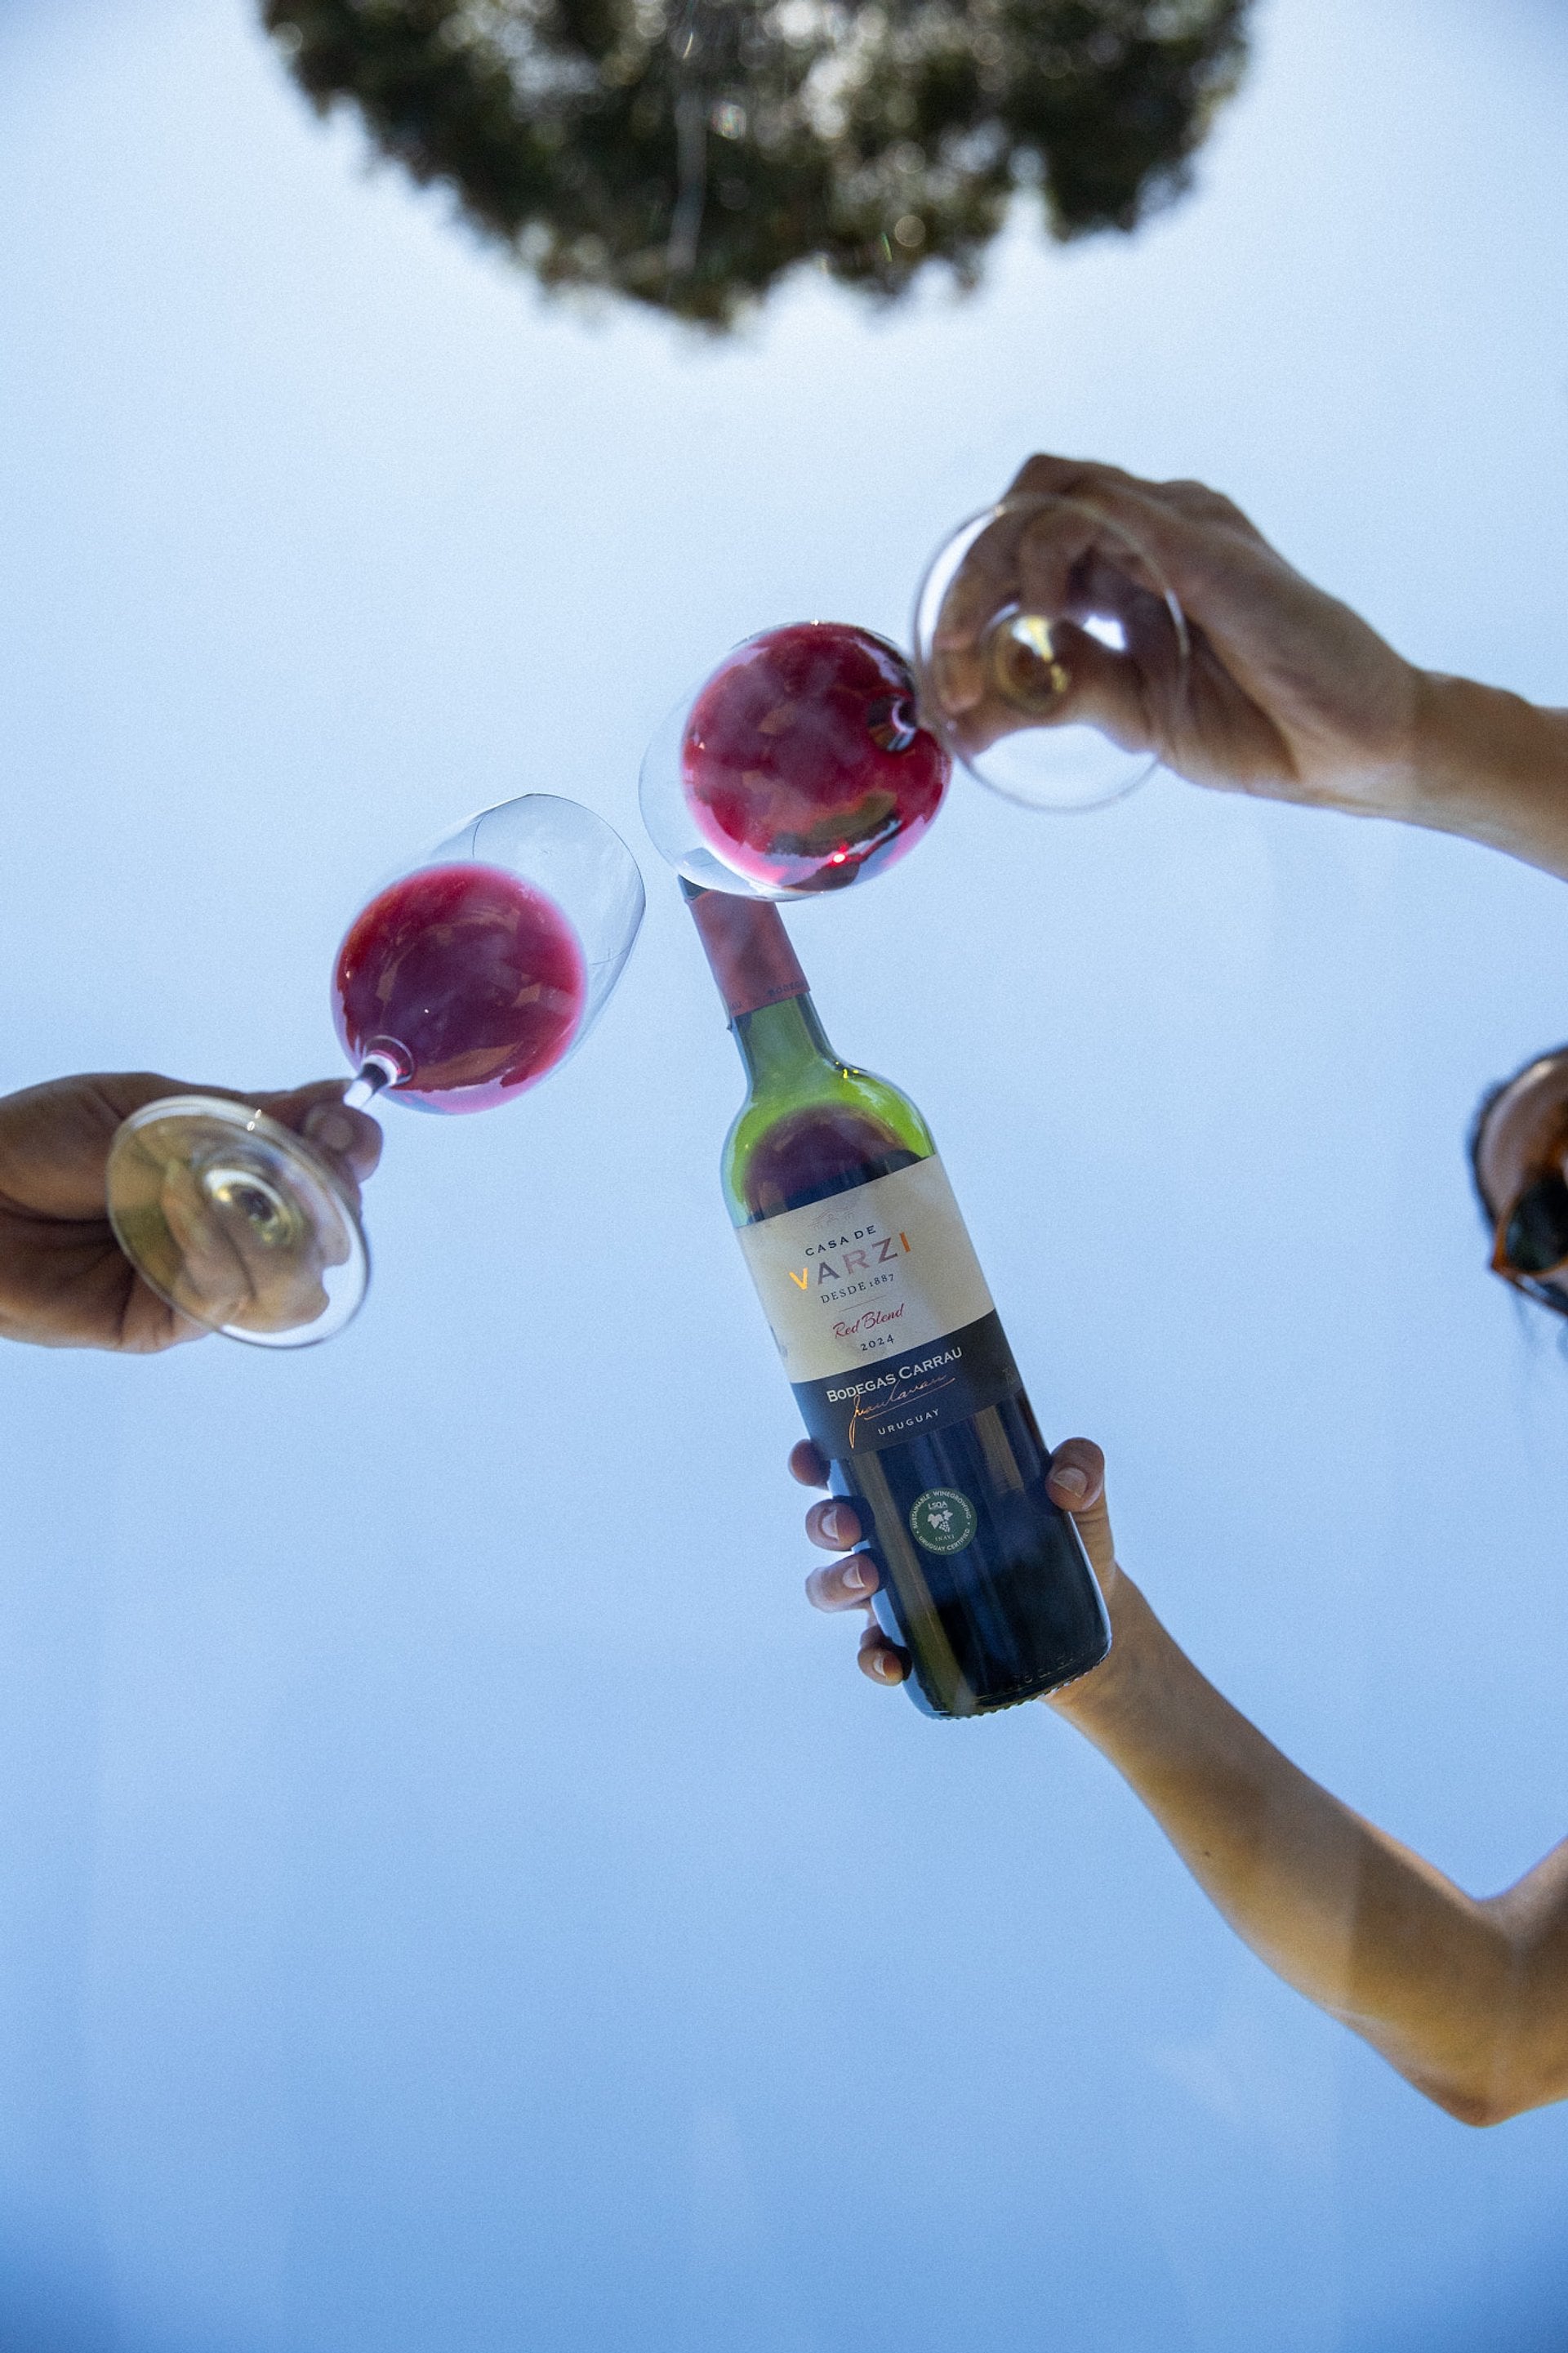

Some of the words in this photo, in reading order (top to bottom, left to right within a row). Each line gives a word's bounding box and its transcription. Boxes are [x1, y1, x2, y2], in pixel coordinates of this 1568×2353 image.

[805, 1235, 849, 1256] CASA
[854, 1225, 876, 1240] DE
[789, 1232, 911, 1290] VARZI
[821, 1281, 866, 1304] DESDE
[869, 1273, 894, 1287] 1887
[832, 1319, 861, 1339] Red
[862, 1303, 905, 1329] Blend
[860, 1334, 895, 1351] 2024
[826, 1374, 897, 1402] BODEGAS
[898, 1347, 963, 1379] CARRAU
[877, 1408, 940, 1435] URUGUAY
[911, 1493, 931, 1529] SUSTAINABLE
[933, 1491, 972, 1519] WINEGROWING
[919, 1535, 946, 1551] URUGUAY
